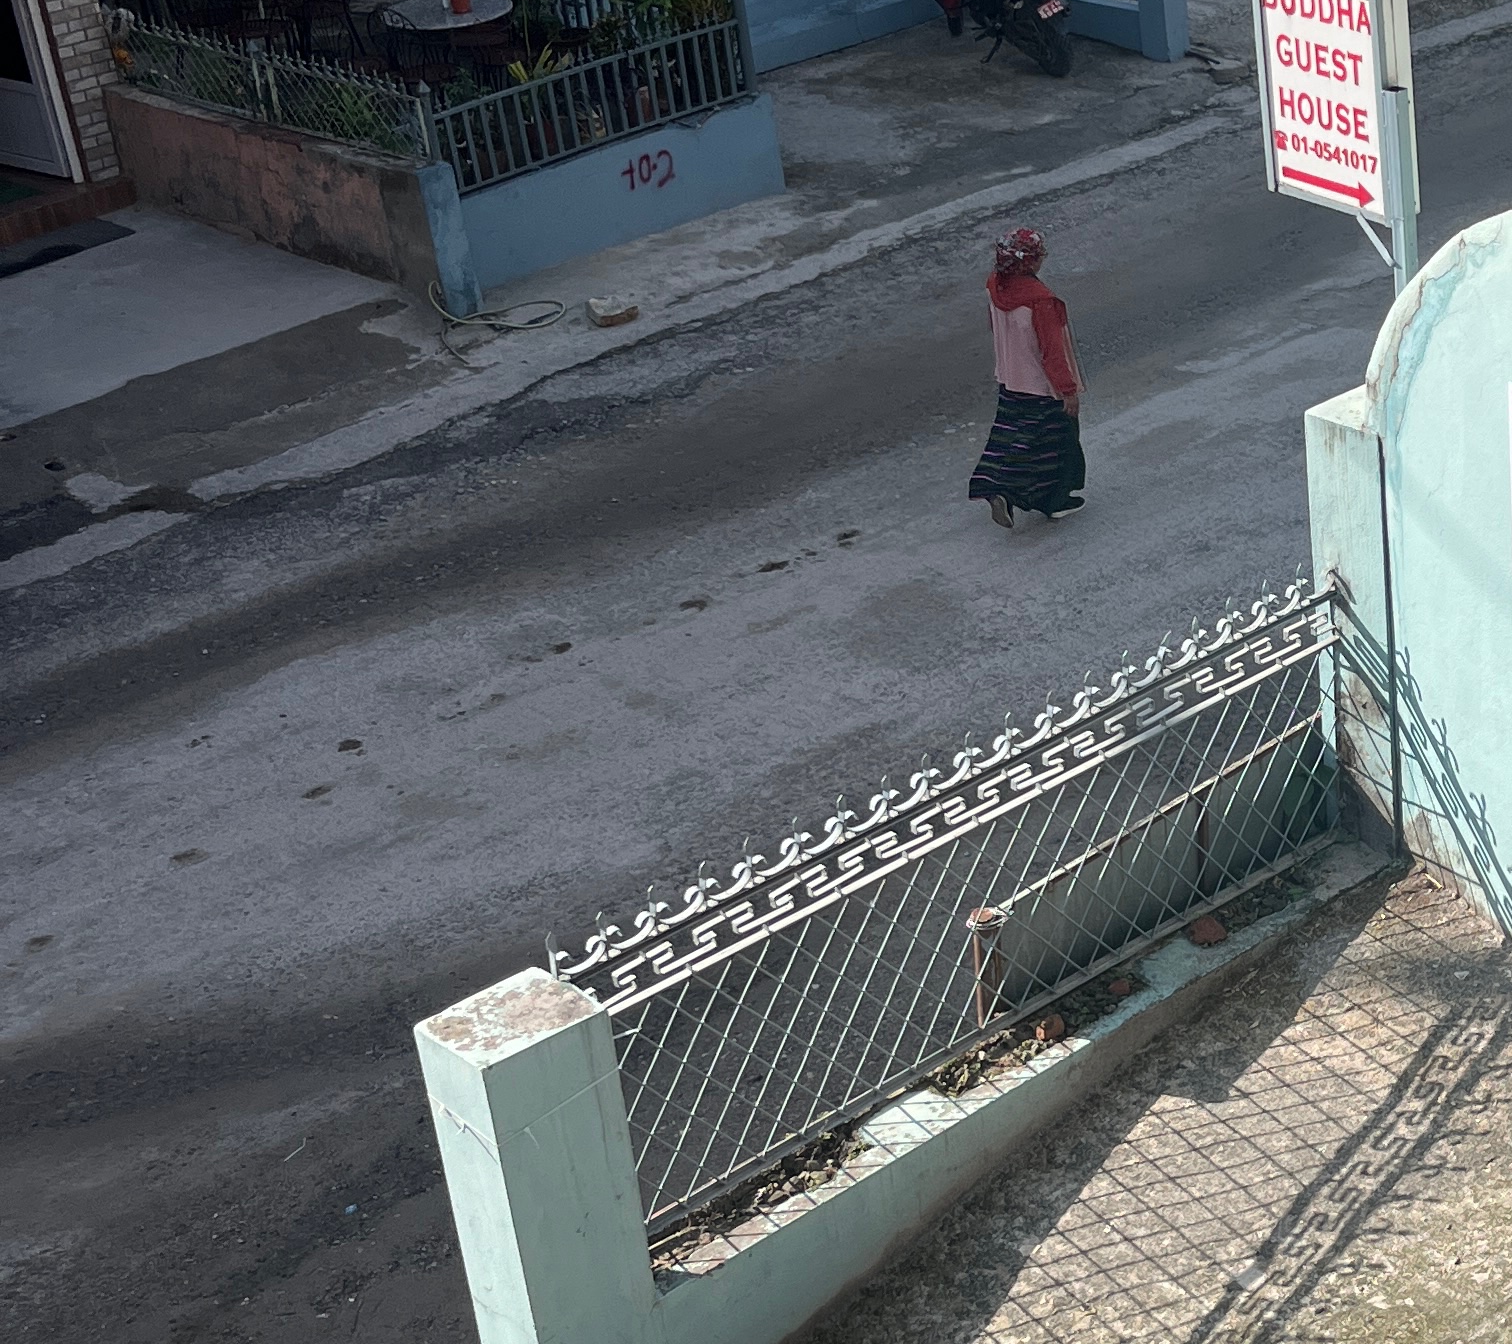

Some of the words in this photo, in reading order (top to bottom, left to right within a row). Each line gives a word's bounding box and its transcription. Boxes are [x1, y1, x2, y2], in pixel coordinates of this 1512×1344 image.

[1276, 34, 1363, 86] GUEST
[1278, 86, 1369, 143] HOUSE
[1291, 133, 1378, 175] 01-0541017
